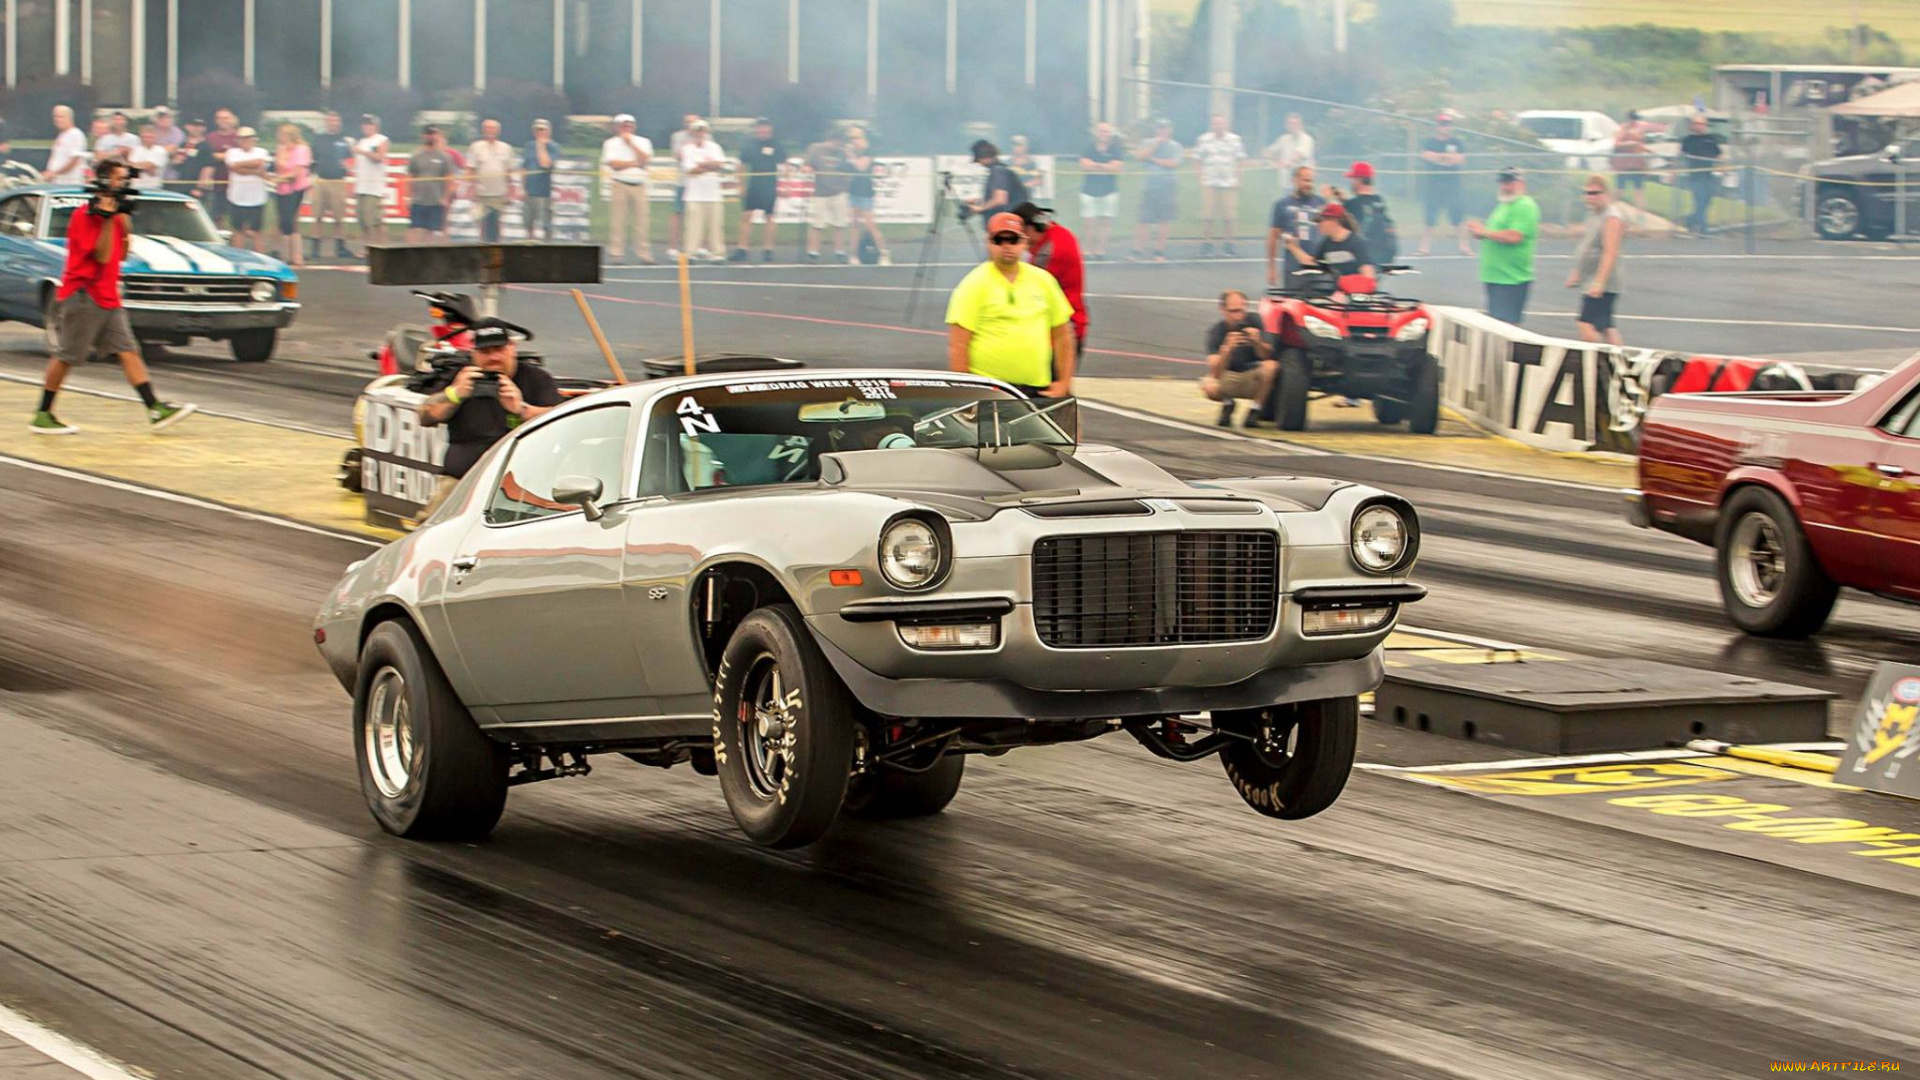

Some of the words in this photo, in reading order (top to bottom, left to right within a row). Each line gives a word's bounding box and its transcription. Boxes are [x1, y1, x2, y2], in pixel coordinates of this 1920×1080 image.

[770, 381, 808, 391] DRAG
[809, 380, 852, 389] WEEK
[676, 396, 705, 415] 4
[680, 413, 721, 437] N
